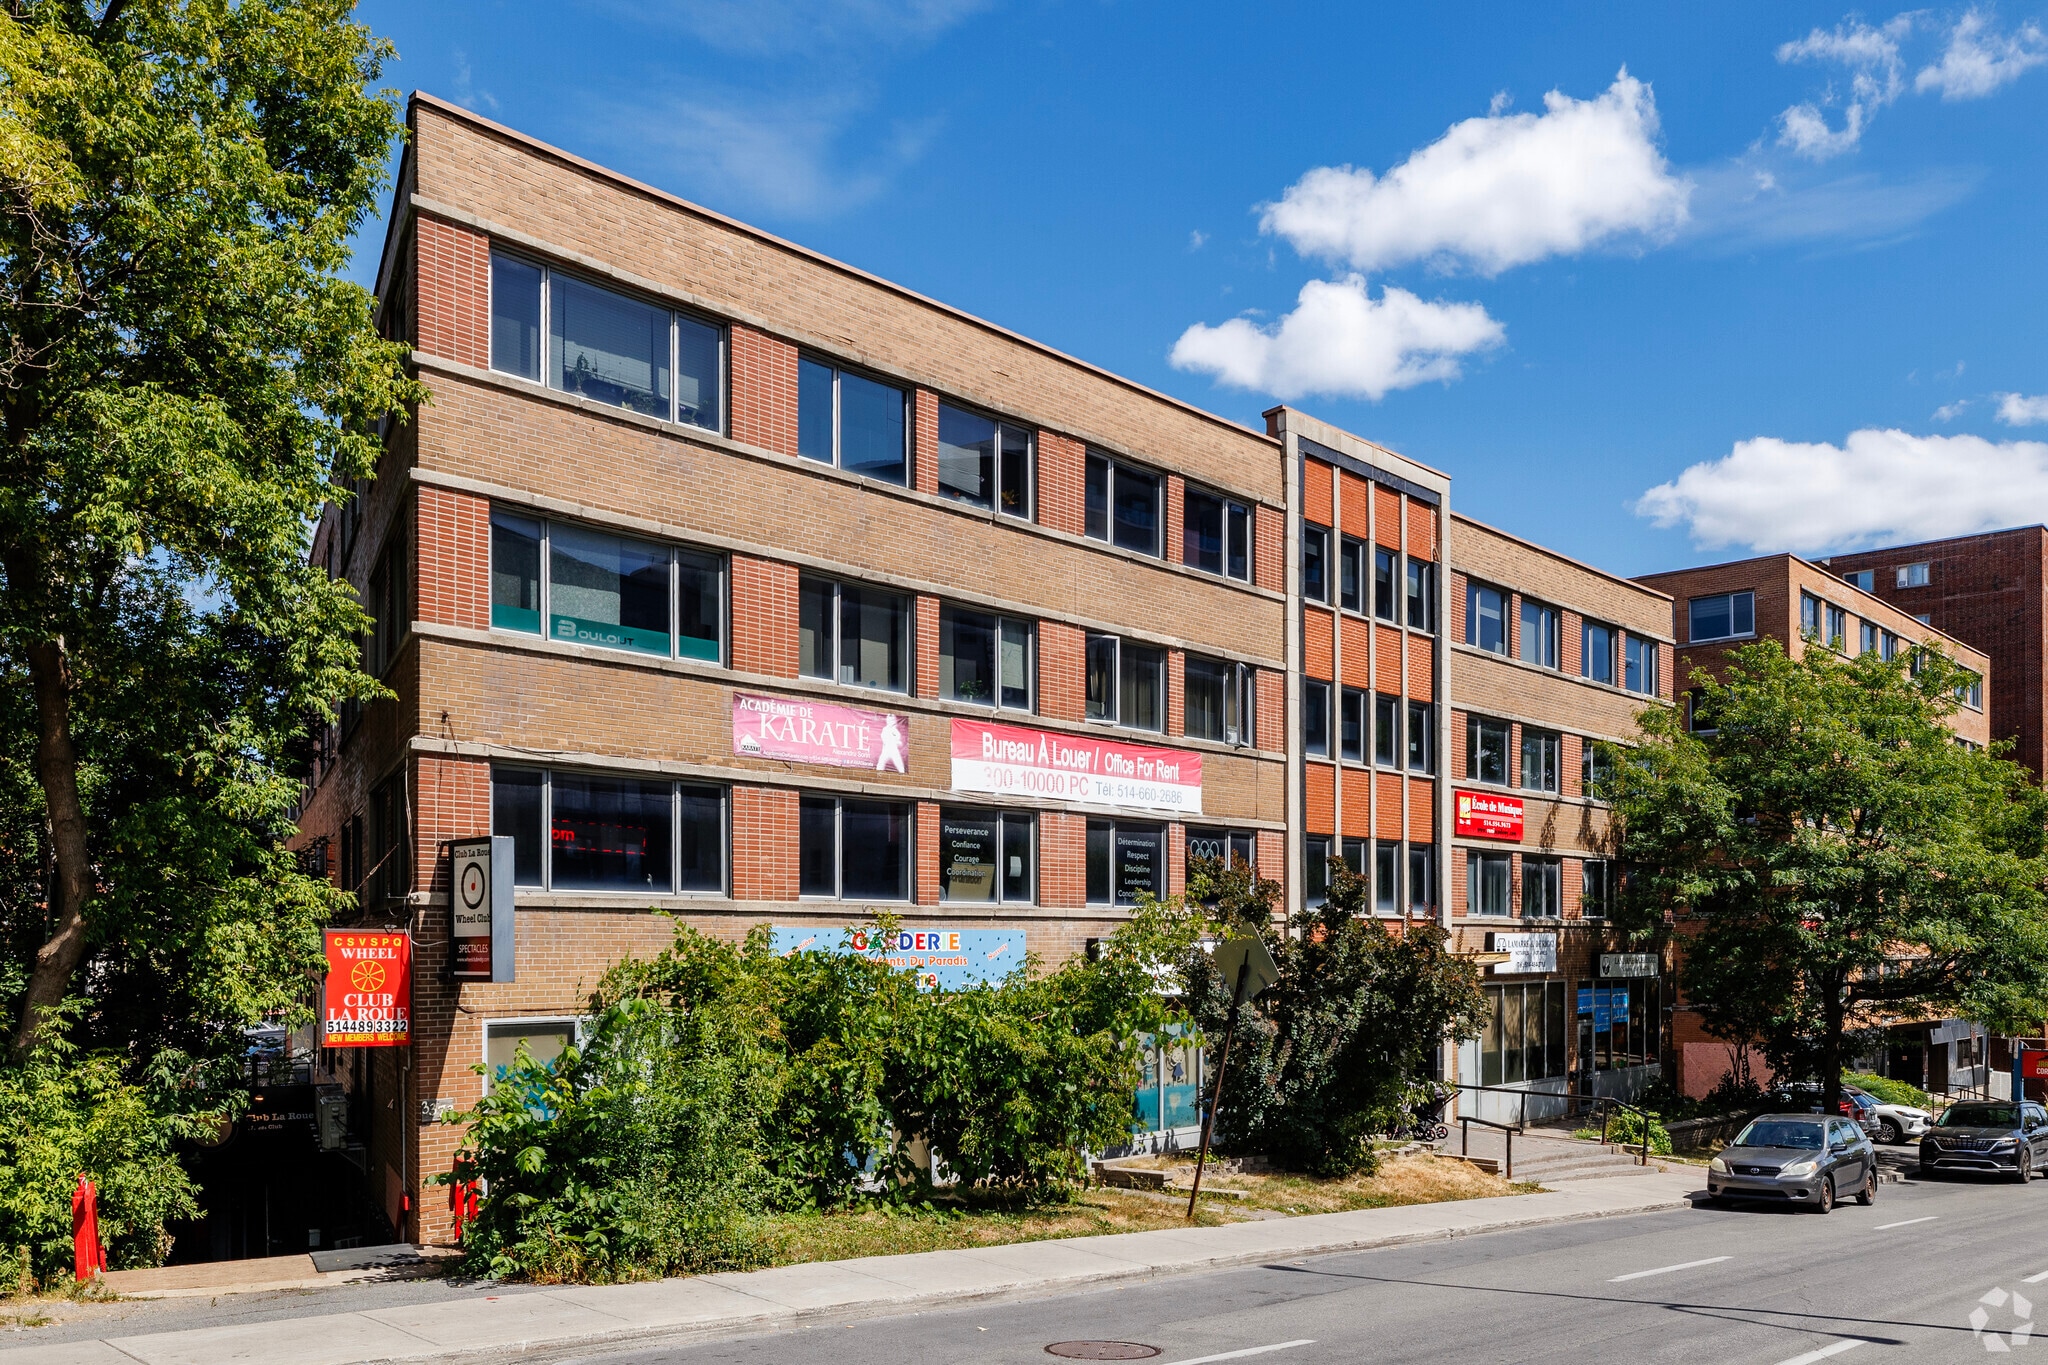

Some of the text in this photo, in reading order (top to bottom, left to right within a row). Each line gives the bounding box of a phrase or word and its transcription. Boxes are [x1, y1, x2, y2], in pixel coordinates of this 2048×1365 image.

[739, 698, 814, 719] ACADÉMIE DE
[757, 712, 871, 753] KARATÉ
[982, 731, 1035, 762] Bureau
[1037, 734, 1050, 765] À
[1052, 741, 1093, 770] Louer
[1104, 752, 1135, 775] Office
[1137, 756, 1154, 777] For
[1156, 760, 1180, 781] Rent
[1069, 774, 1089, 796] PC
[1095, 780, 1115, 798] Tél:
[1117, 784, 1183, 805] 514-660-2686
[1472, 795, 1523, 818] École de Musique
[944, 825, 989, 836] Perseverance
[951, 840, 981, 850] Confiance
[1117, 837, 1156, 848] Détermination
[455, 849, 467, 859] Club
[468, 849, 476, 858] La
[953, 854, 980, 865] Courage
[1126, 850, 1149, 861] Respect
[946, 867, 986, 877] Coordination
[1124, 864, 1151, 874] Discipline
[1124, 878, 1152, 887] Leadership
[455, 913, 476, 924] Wheel
[340, 947, 397, 960] WHEEL
[458, 943, 489, 954] SPECTACLES
[909, 956, 925, 966] Du
[928, 955, 968, 966] Paradis
[343, 993, 394, 1007] CLUB
[329, 1007, 407, 1021] LA ROUE
[376, 1020, 407, 1032] 3322
[329, 1032, 407, 1042] NEW MEMBERS WELCOME
[271, 1113, 286, 1121] La
[288, 1112, 315, 1120] Roue
